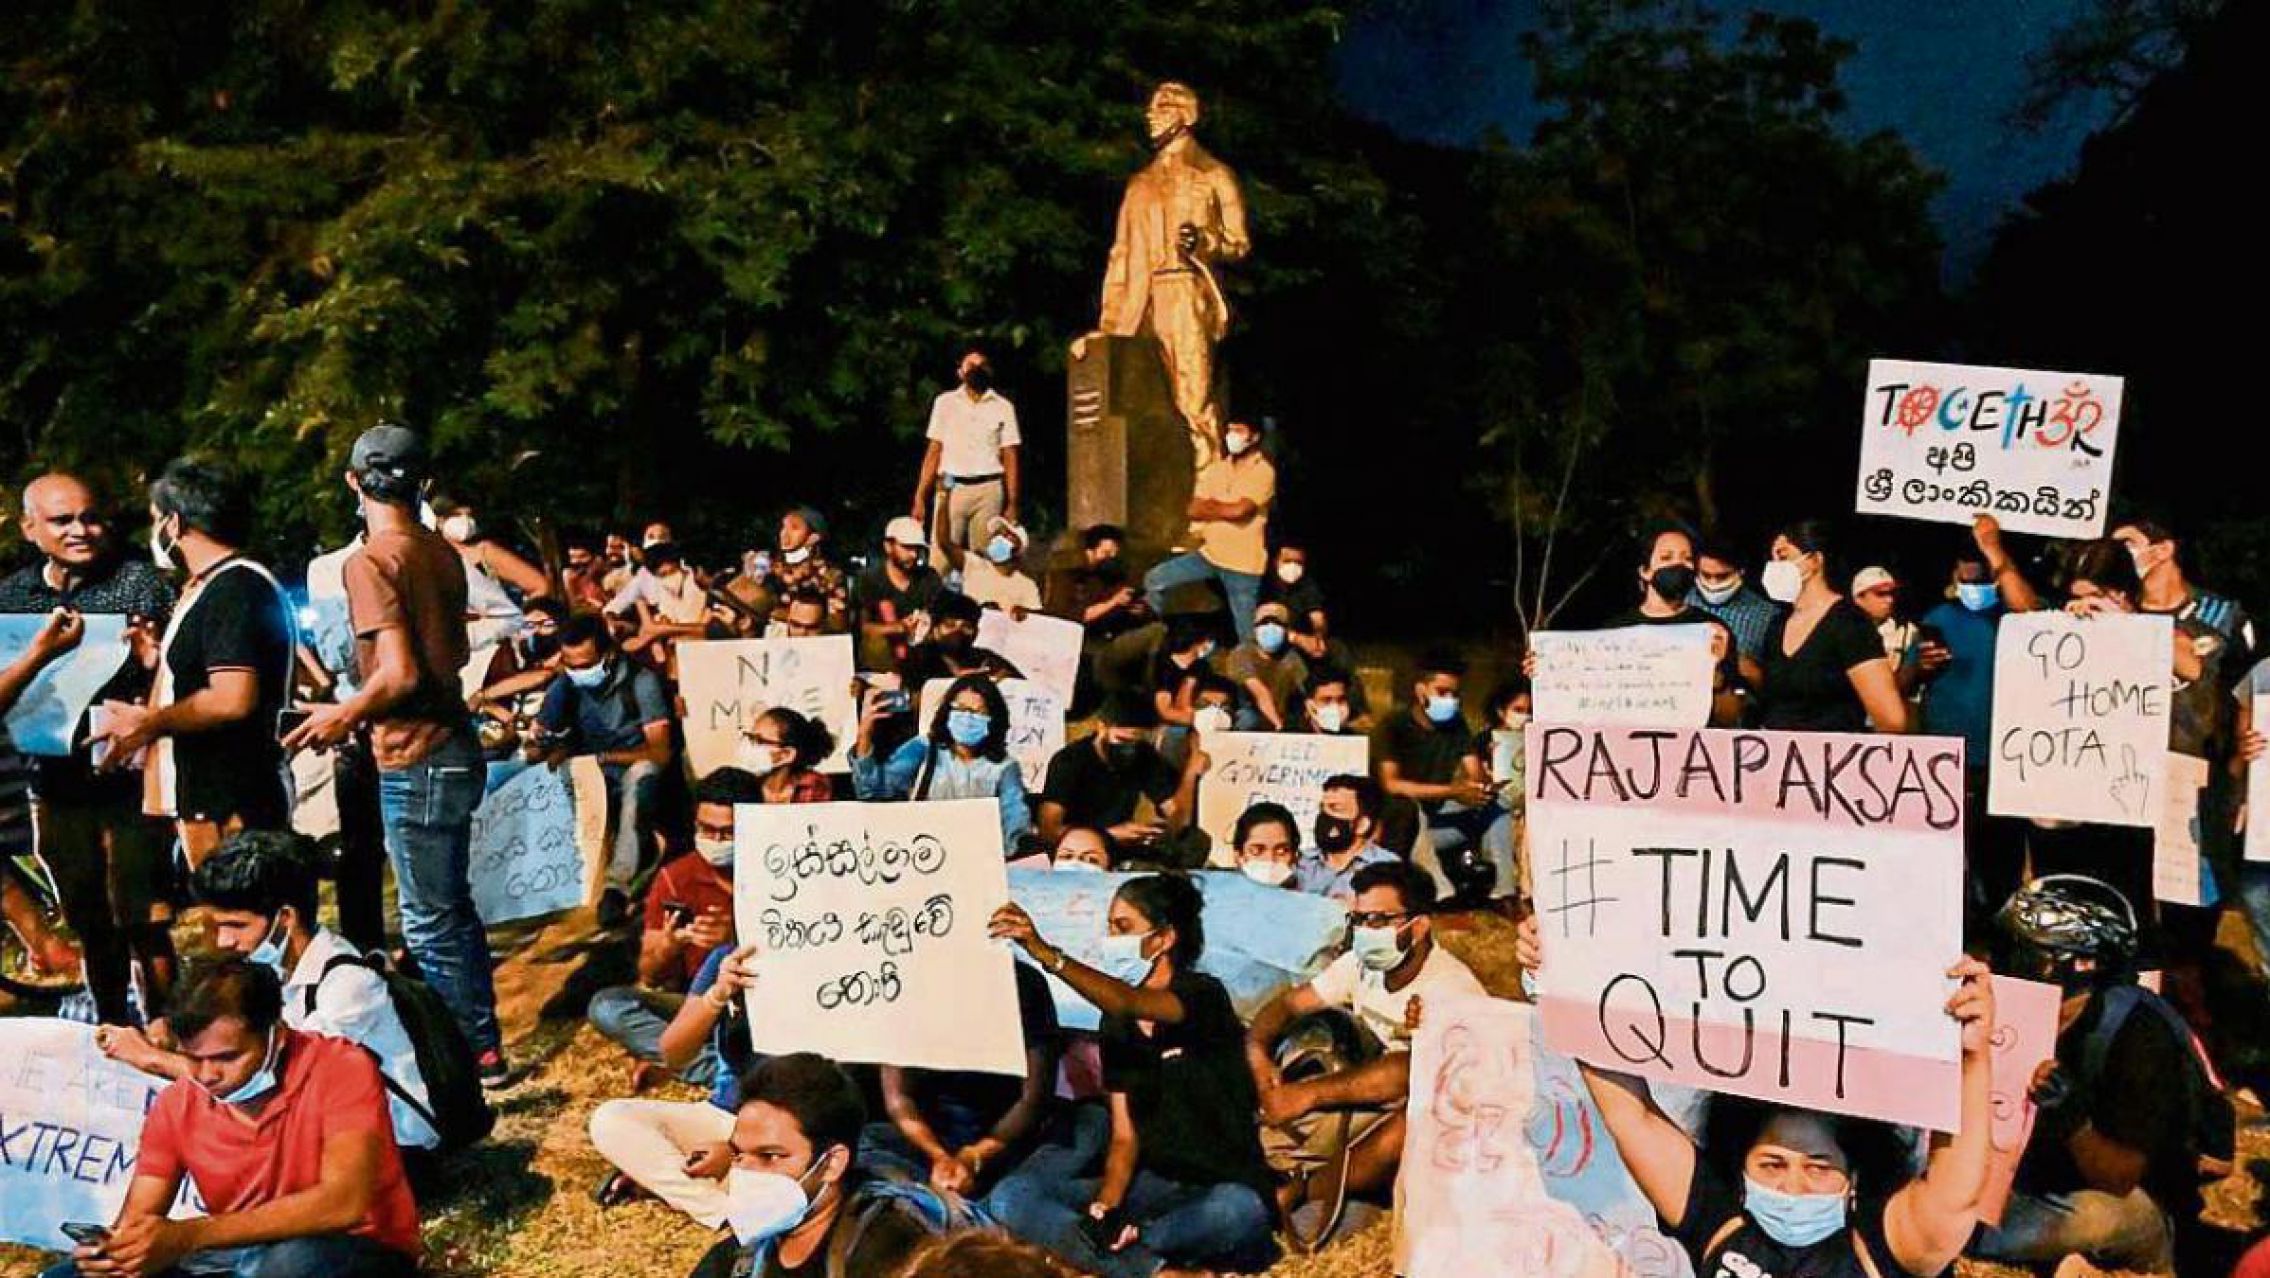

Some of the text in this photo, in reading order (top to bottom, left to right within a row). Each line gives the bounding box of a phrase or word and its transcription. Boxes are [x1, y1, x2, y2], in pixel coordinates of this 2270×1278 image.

[1926, 442, 1976, 475] අපි
[2028, 631, 2085, 678] GO
[2051, 679, 2161, 718] HOME
[1537, 727, 1960, 830] RAJAPAKSAS
[2001, 727, 2106, 782] GOTA
[1672, 949, 1766, 1002] TO
[1598, 972, 1875, 1099] QUIT
